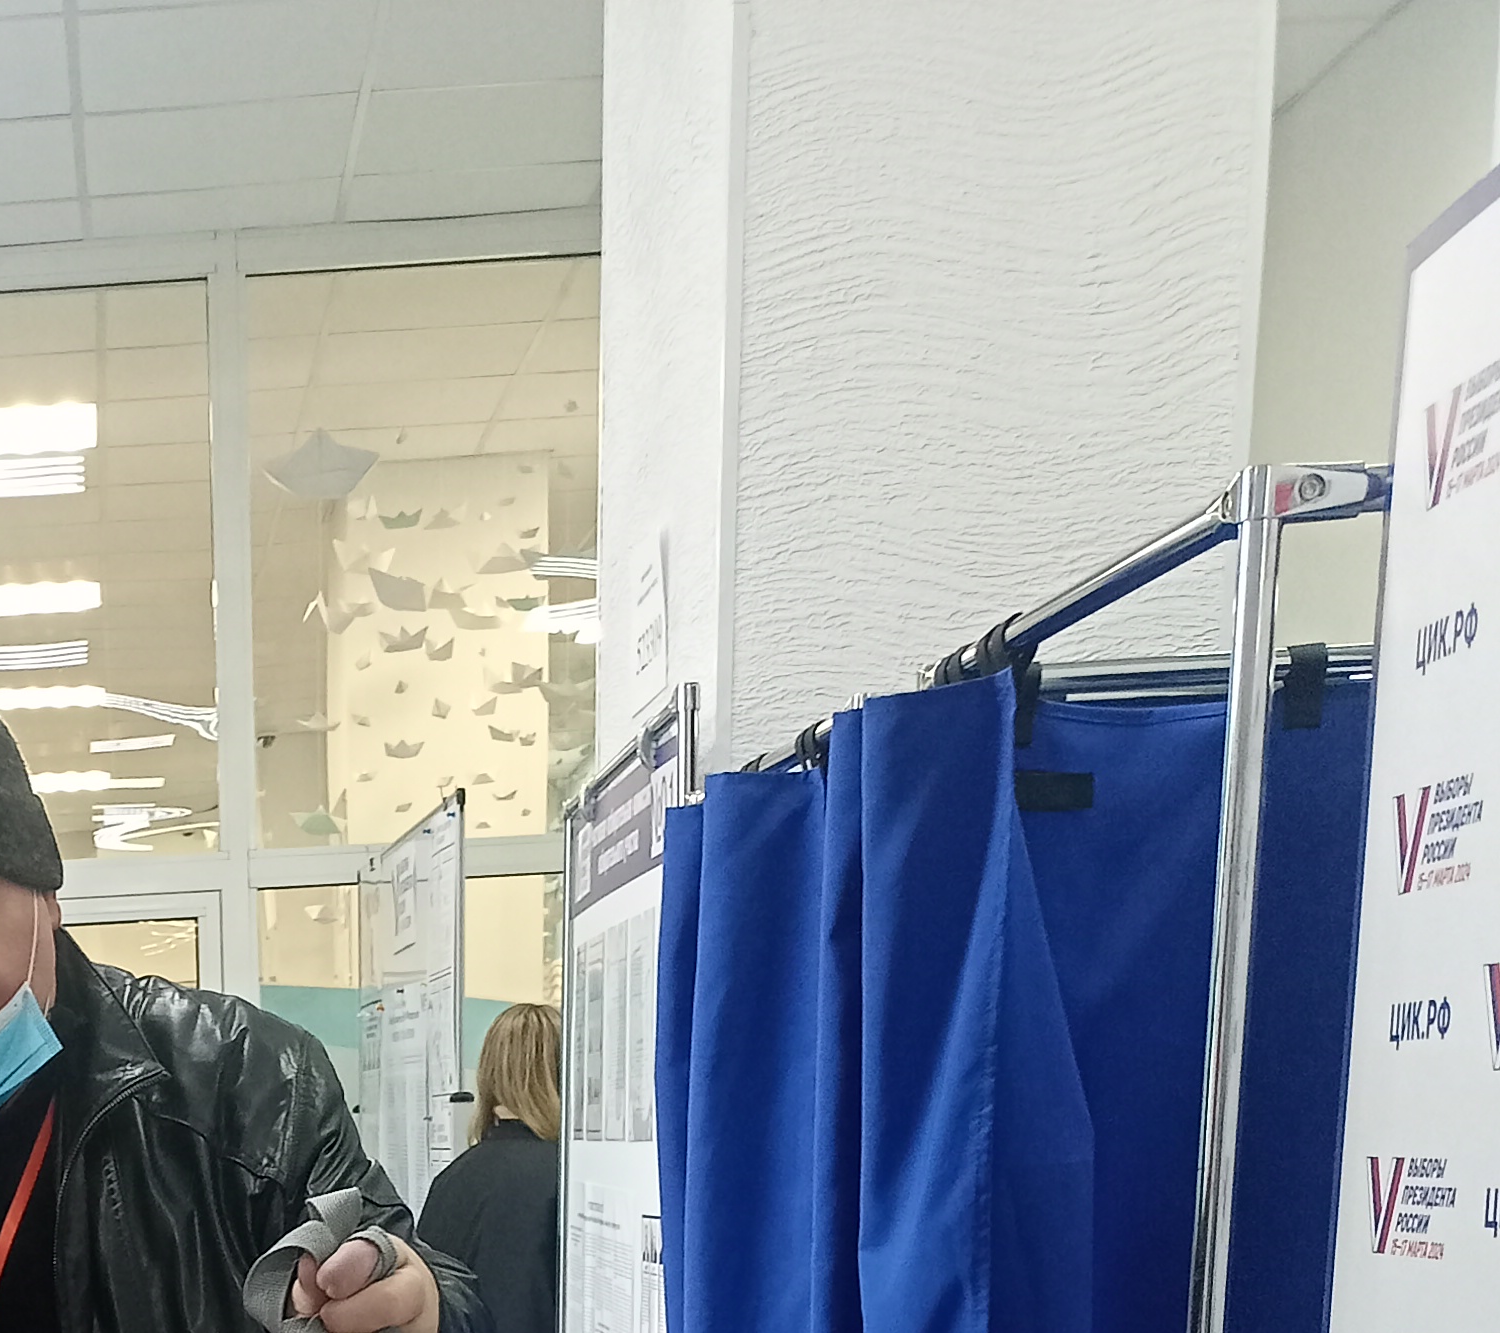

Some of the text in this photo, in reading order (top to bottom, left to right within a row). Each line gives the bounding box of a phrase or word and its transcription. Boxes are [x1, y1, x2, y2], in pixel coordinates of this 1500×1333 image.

[1416, 602, 1478, 676] ЦИК.РФ
[1433, 772, 1474, 804] ВЫБОРЫ
[1427, 800, 1484, 835] ПРЕЗИДЕНТА
[1421, 838, 1457, 865] РОССИИ
[1389, 996, 1451, 1051] ЦИК.РФ
[1407, 1158, 1447, 1179] ВЫБОРЫ
[1400, 1187, 1457, 1208] ПРЕЗИДЕНТА
[1395, 1213, 1430, 1234] РОССИИ
